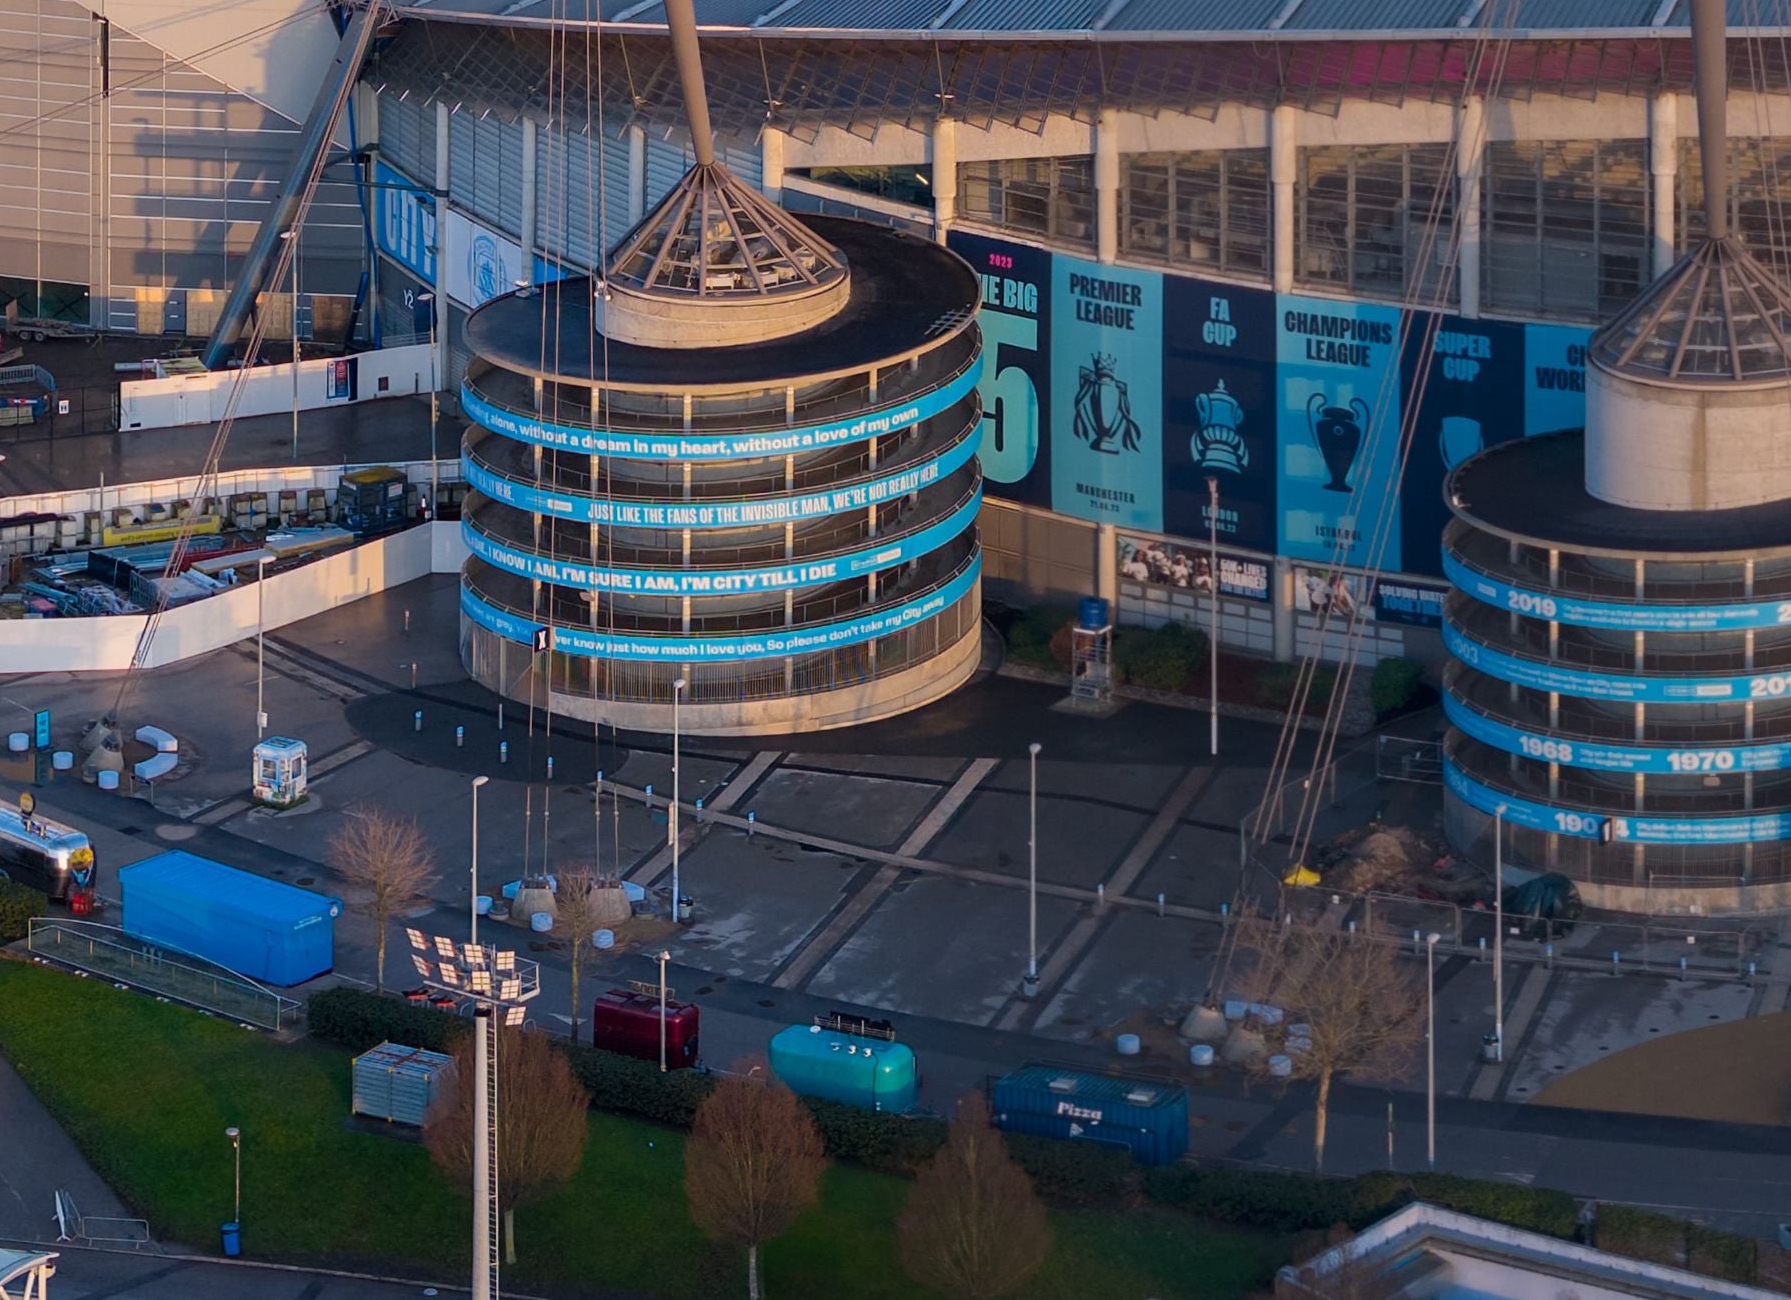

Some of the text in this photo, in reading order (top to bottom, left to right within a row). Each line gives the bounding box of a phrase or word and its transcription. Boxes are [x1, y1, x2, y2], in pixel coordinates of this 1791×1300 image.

[989, 253, 1013, 268] 2023
[1003, 280, 1037, 314] BIG
[1070, 273, 1142, 307] PREMIER
[1076, 300, 1135, 331] LEAGUE
[1209, 297, 1230, 321] FA
[1202, 321, 1237, 347] CUP
[1285, 310, 1392, 346] CHAMPIONS
[1306, 341, 1371, 368] LEAGUE
[1433, 331, 1492, 359] SUPER
[1442, 359, 1480, 381] CUP
[976, 308, 1039, 485] 5
[520, 408, 918, 456] without dream my heart, without love of my own
[588, 474, 918, 524] JUST LIKE THE FANS OF THE INVISIBLE MAN, WE'RE NOT REALLY
[1076, 483, 1135, 504] MANCHESTER
[493, 548, 836, 591] KNOW I'M SURE AM, I'M CITY TILL DIE
[1507, 590, 1557, 617] 2019
[574, 604, 921, 655] know how much love So please don't take City
[1519, 736, 1734, 771] 1968 1970
[1057, 1101, 1103, 1121] Pizza
